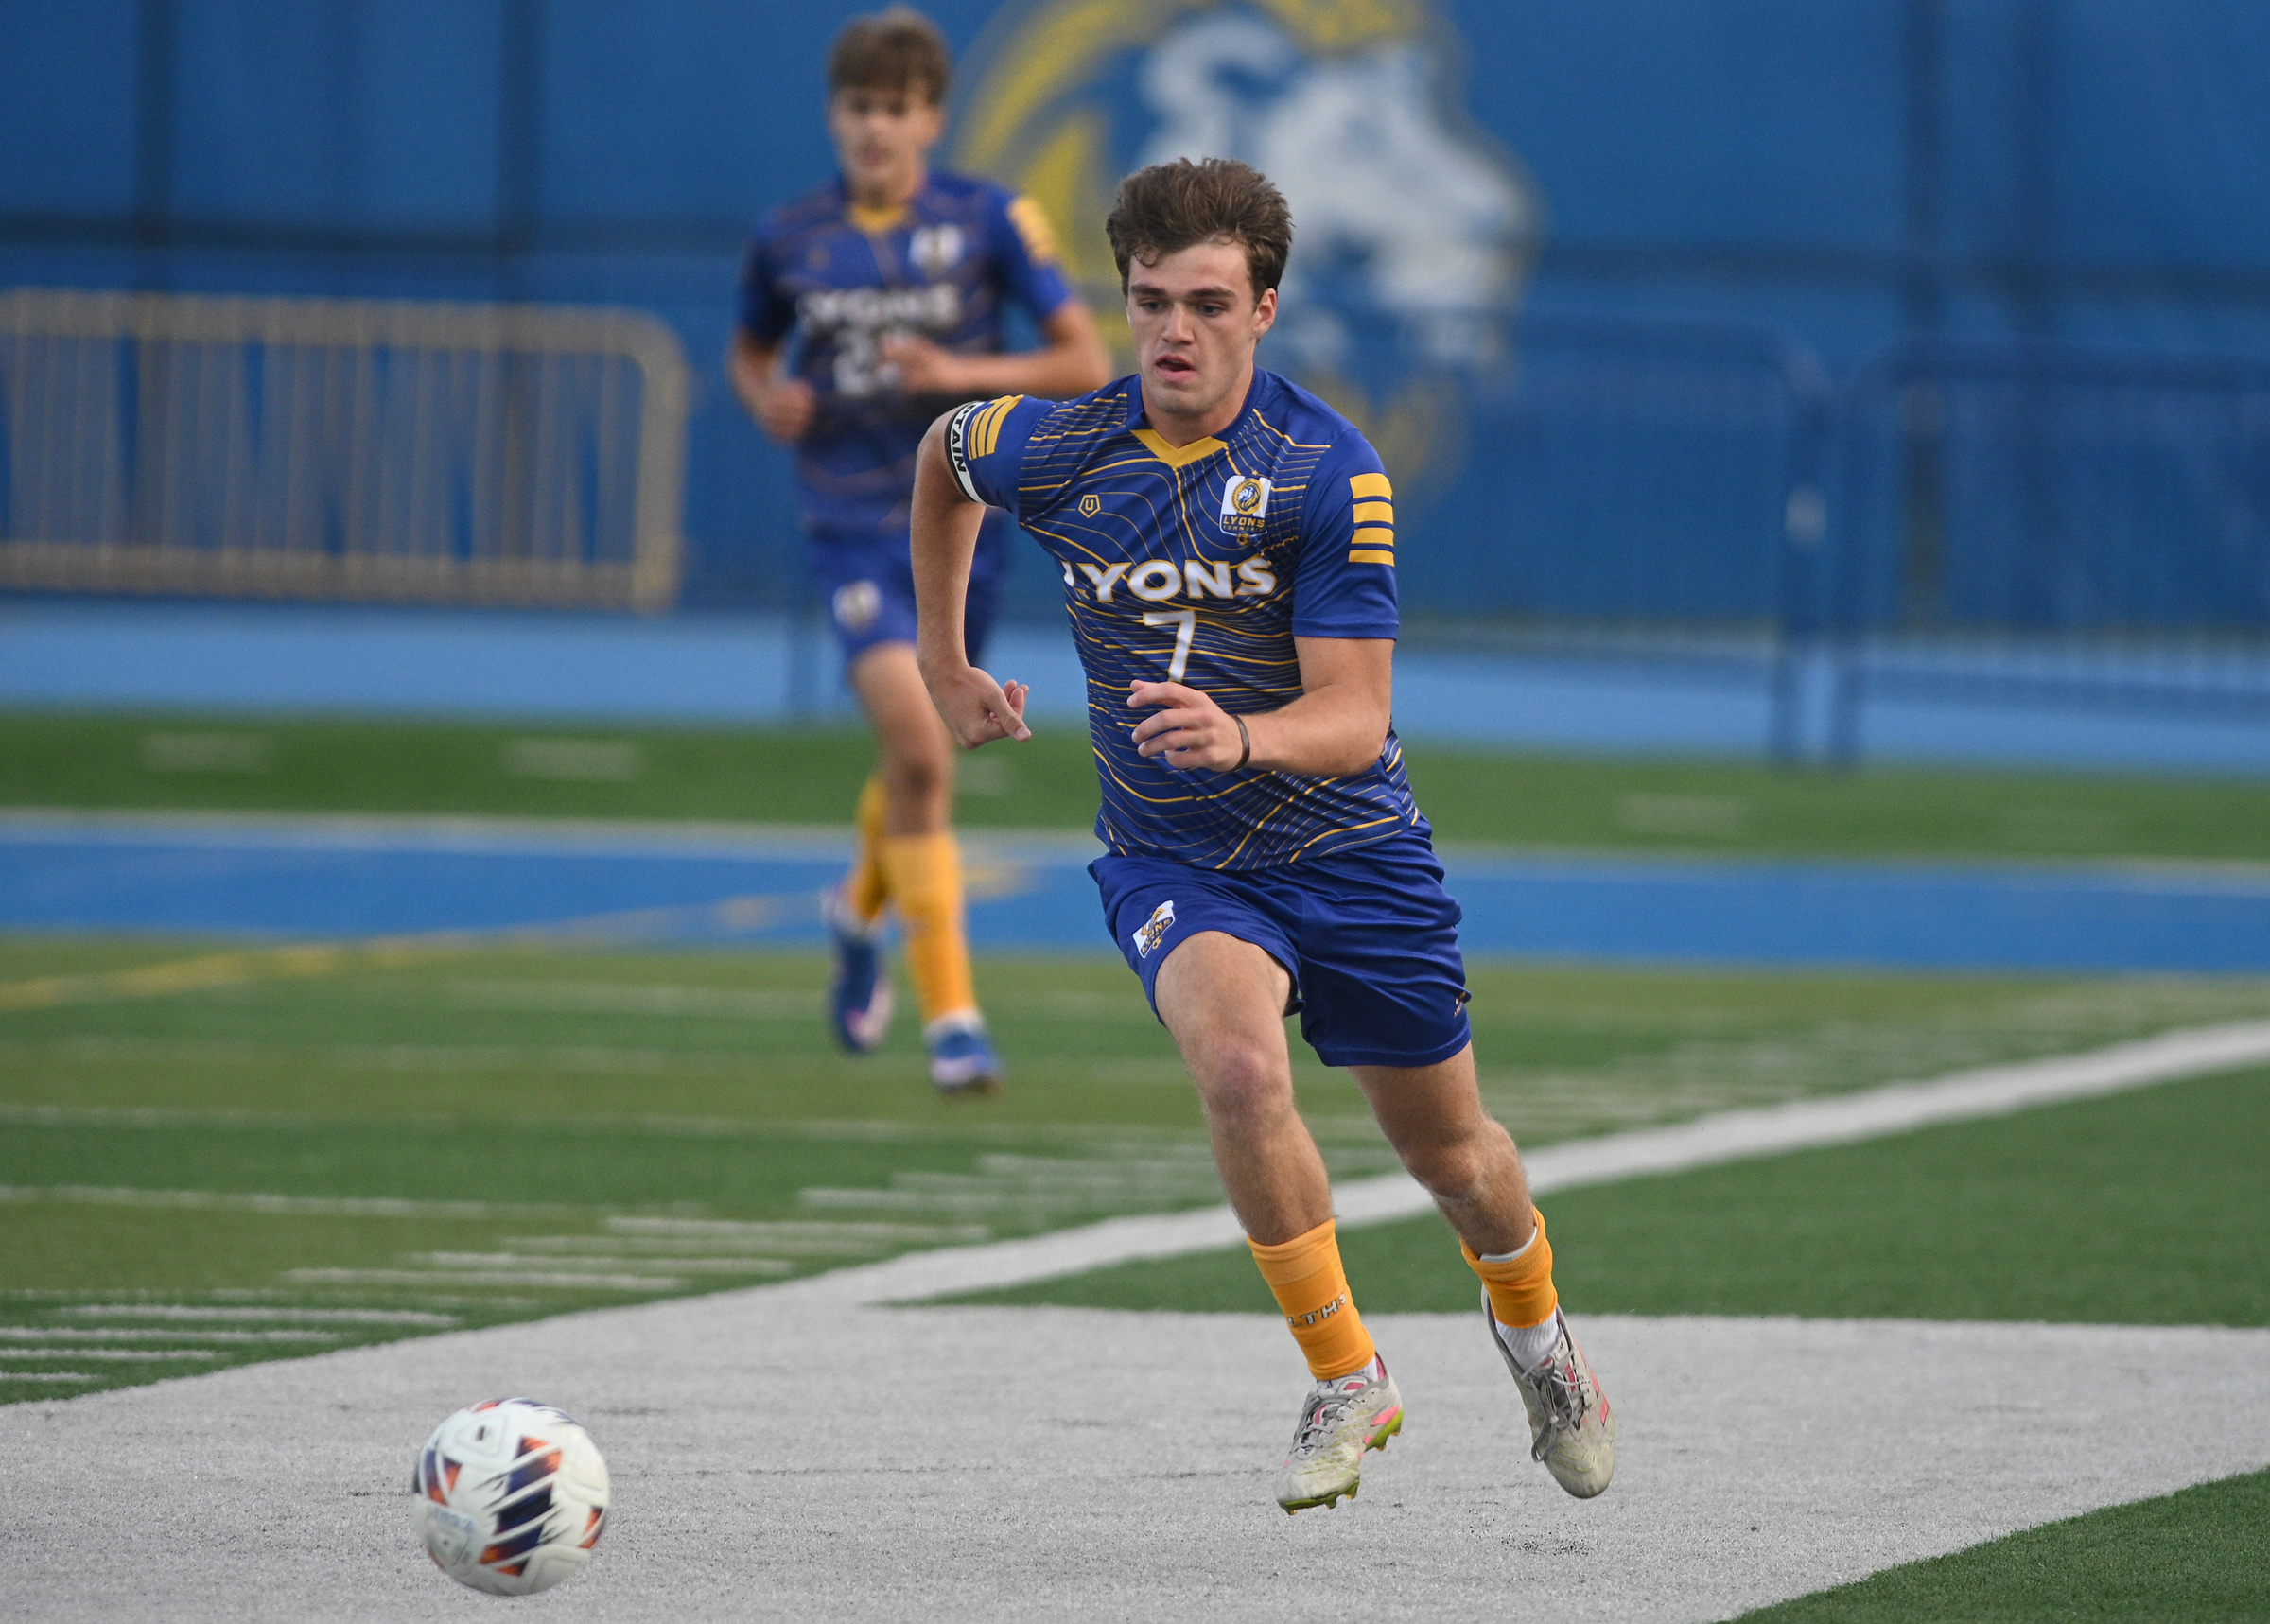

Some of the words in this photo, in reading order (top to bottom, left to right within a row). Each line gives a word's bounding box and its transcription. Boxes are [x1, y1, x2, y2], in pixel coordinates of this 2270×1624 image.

[797, 284, 959, 331] YONS
[952, 404, 977, 473] PTAIN
[1222, 515, 1266, 528] LYONS
[1143, 609, 1196, 683] 7
